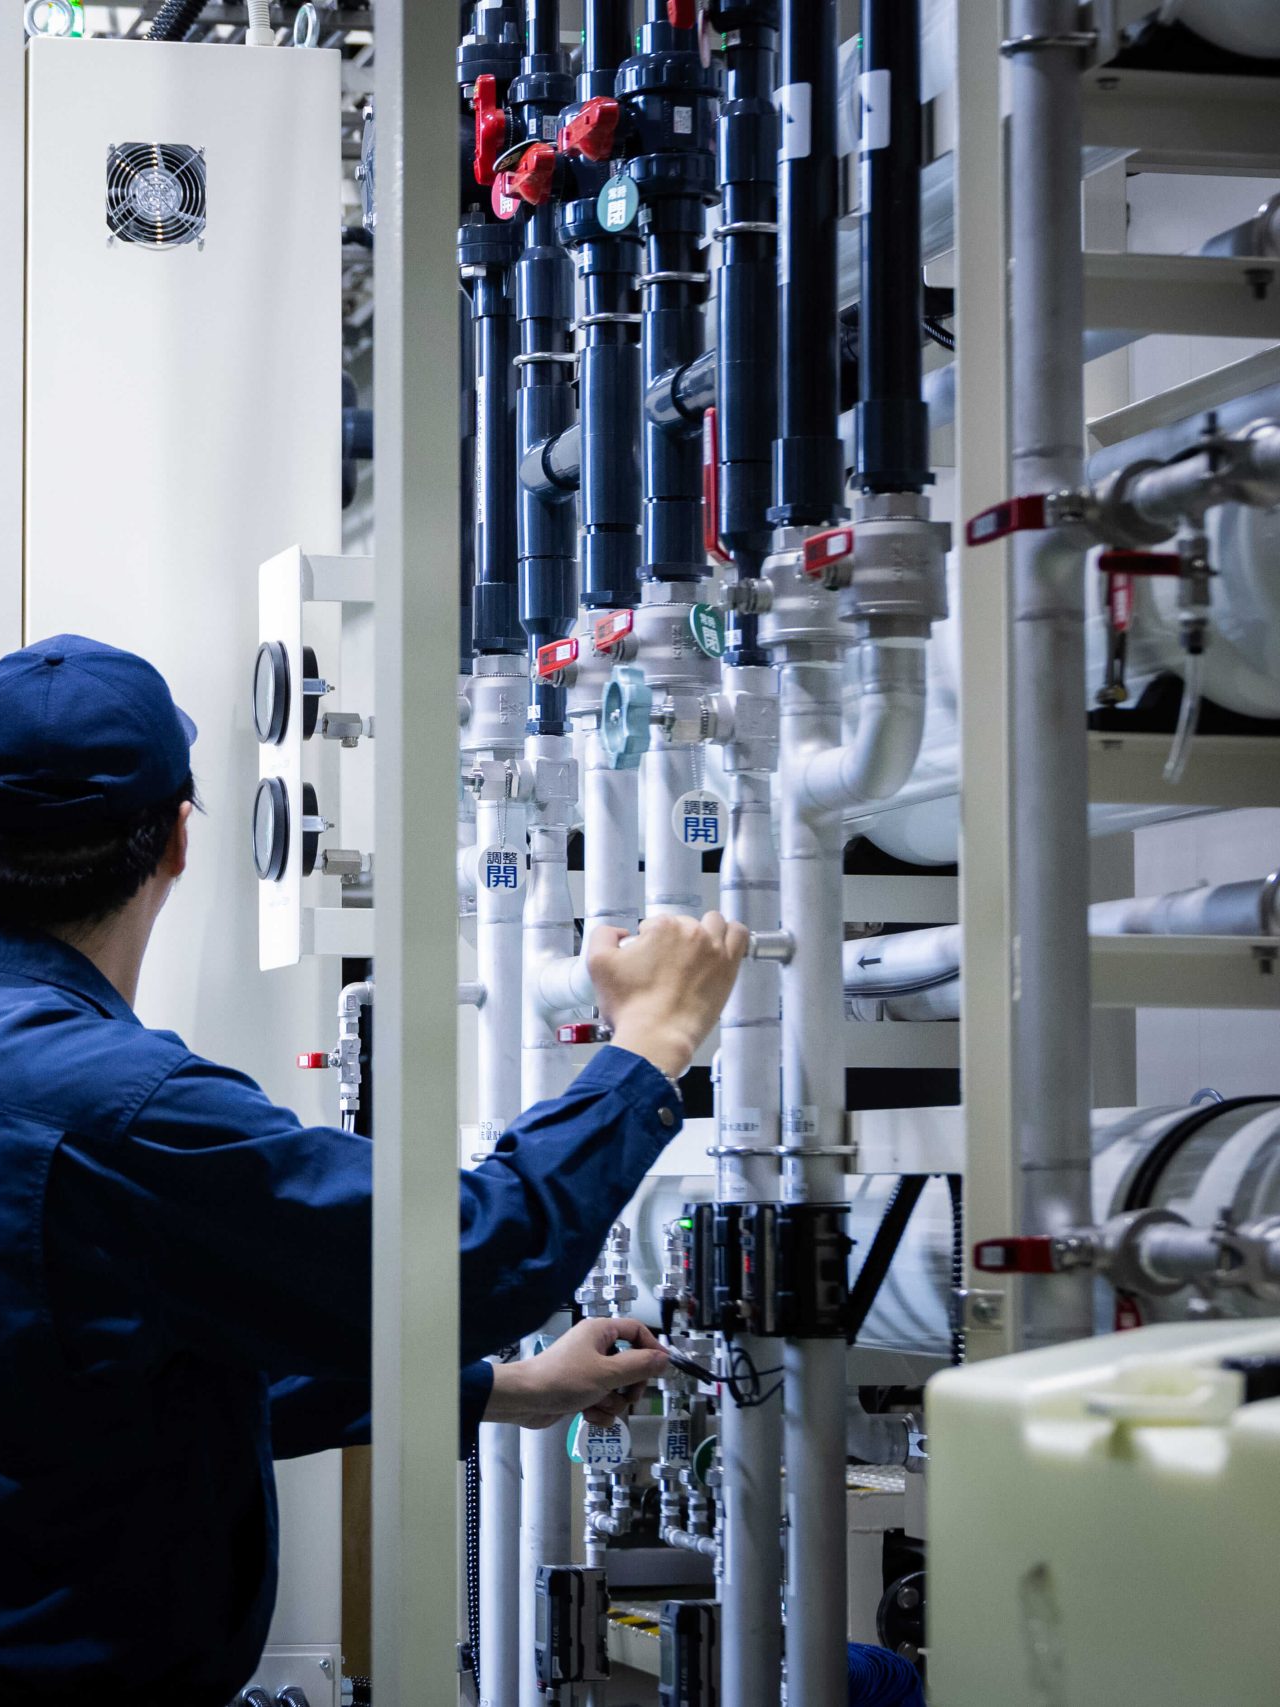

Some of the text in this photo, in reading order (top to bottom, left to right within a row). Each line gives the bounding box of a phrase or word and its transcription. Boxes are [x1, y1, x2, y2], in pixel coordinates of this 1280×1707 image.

[683, 800, 719, 815] 調整
[684, 816, 719, 843] 開
[487, 851, 518, 864] 調整
[487, 865, 518, 888] 開
[667, 1434, 690, 1460] 開
